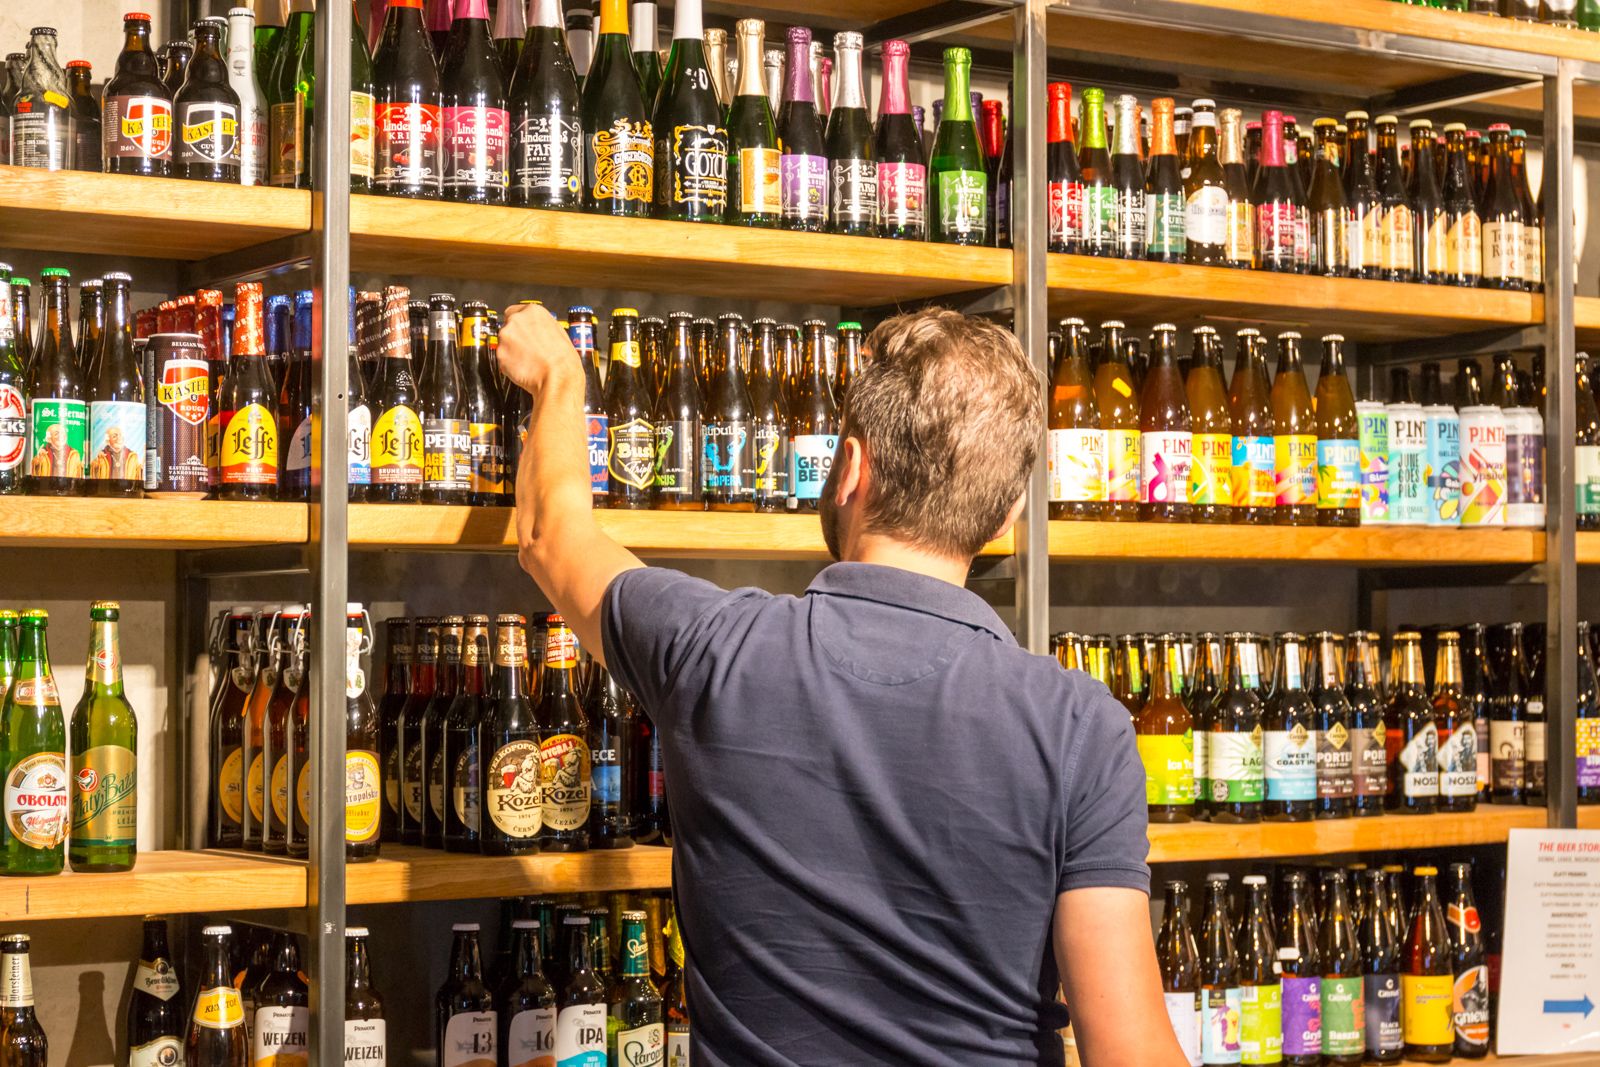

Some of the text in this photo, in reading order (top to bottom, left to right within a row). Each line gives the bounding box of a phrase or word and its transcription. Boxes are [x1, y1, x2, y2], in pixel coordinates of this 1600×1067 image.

[232, 426, 274, 460] Leffe
[379, 427, 420, 461] Leffe
[1398, 453, 1419, 467] JUNE
[1398, 484, 1417, 498] PILS
[497, 791, 541, 812] Kozel
[541, 786, 588, 806] Kozel
[1539, 842, 1553, 852] THE
[1556, 842, 1576, 852] BEER
[263, 1031, 306, 1046] WEIZEN
[473, 1031, 492, 1054] 13
[536, 1028, 555, 1050] 16
[579, 1027, 604, 1045] IPA
[345, 1045, 384, 1061] WEIZEN
